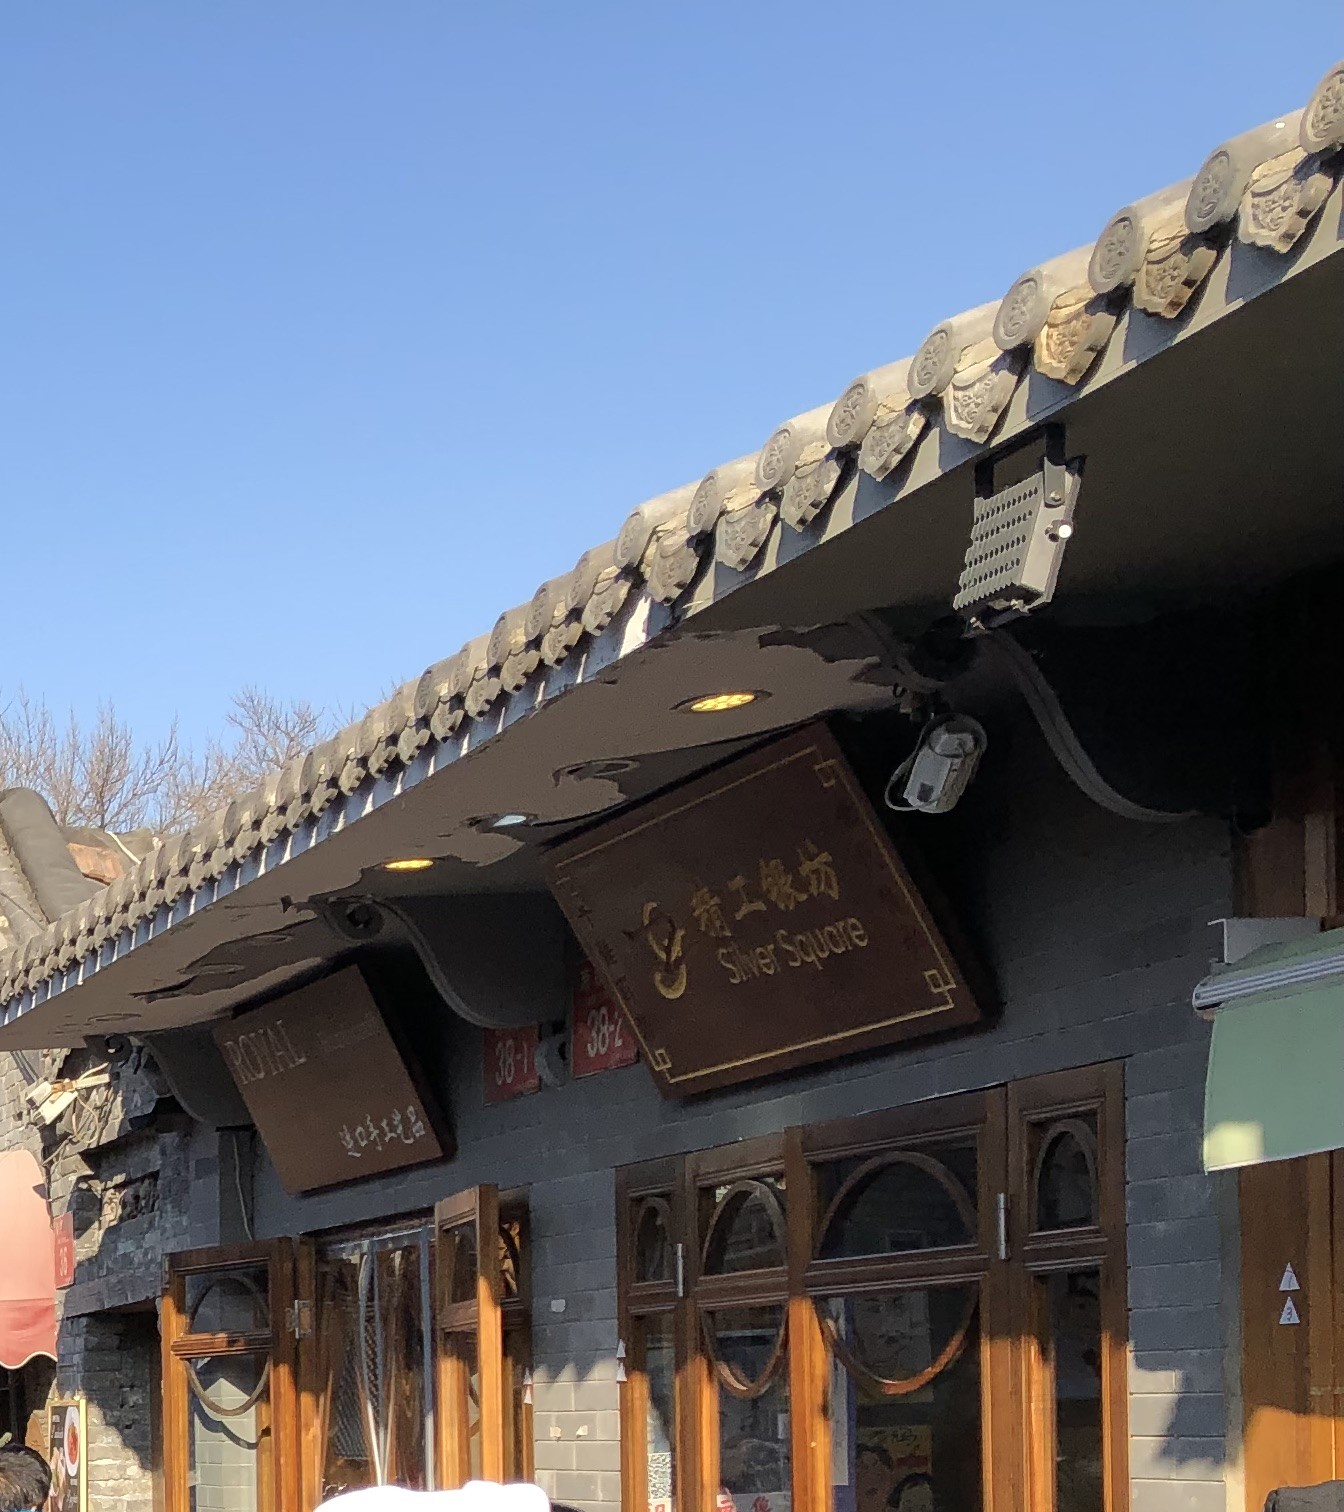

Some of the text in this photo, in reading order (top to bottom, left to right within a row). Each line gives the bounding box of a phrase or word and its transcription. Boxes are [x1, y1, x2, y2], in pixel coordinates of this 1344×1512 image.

[717, 917, 869, 985] Silver Square
[223, 1018, 308, 1086] ROYAL
[586, 1005, 624, 1058] 38-2
[495, 1038, 529, 1086] 38-1
